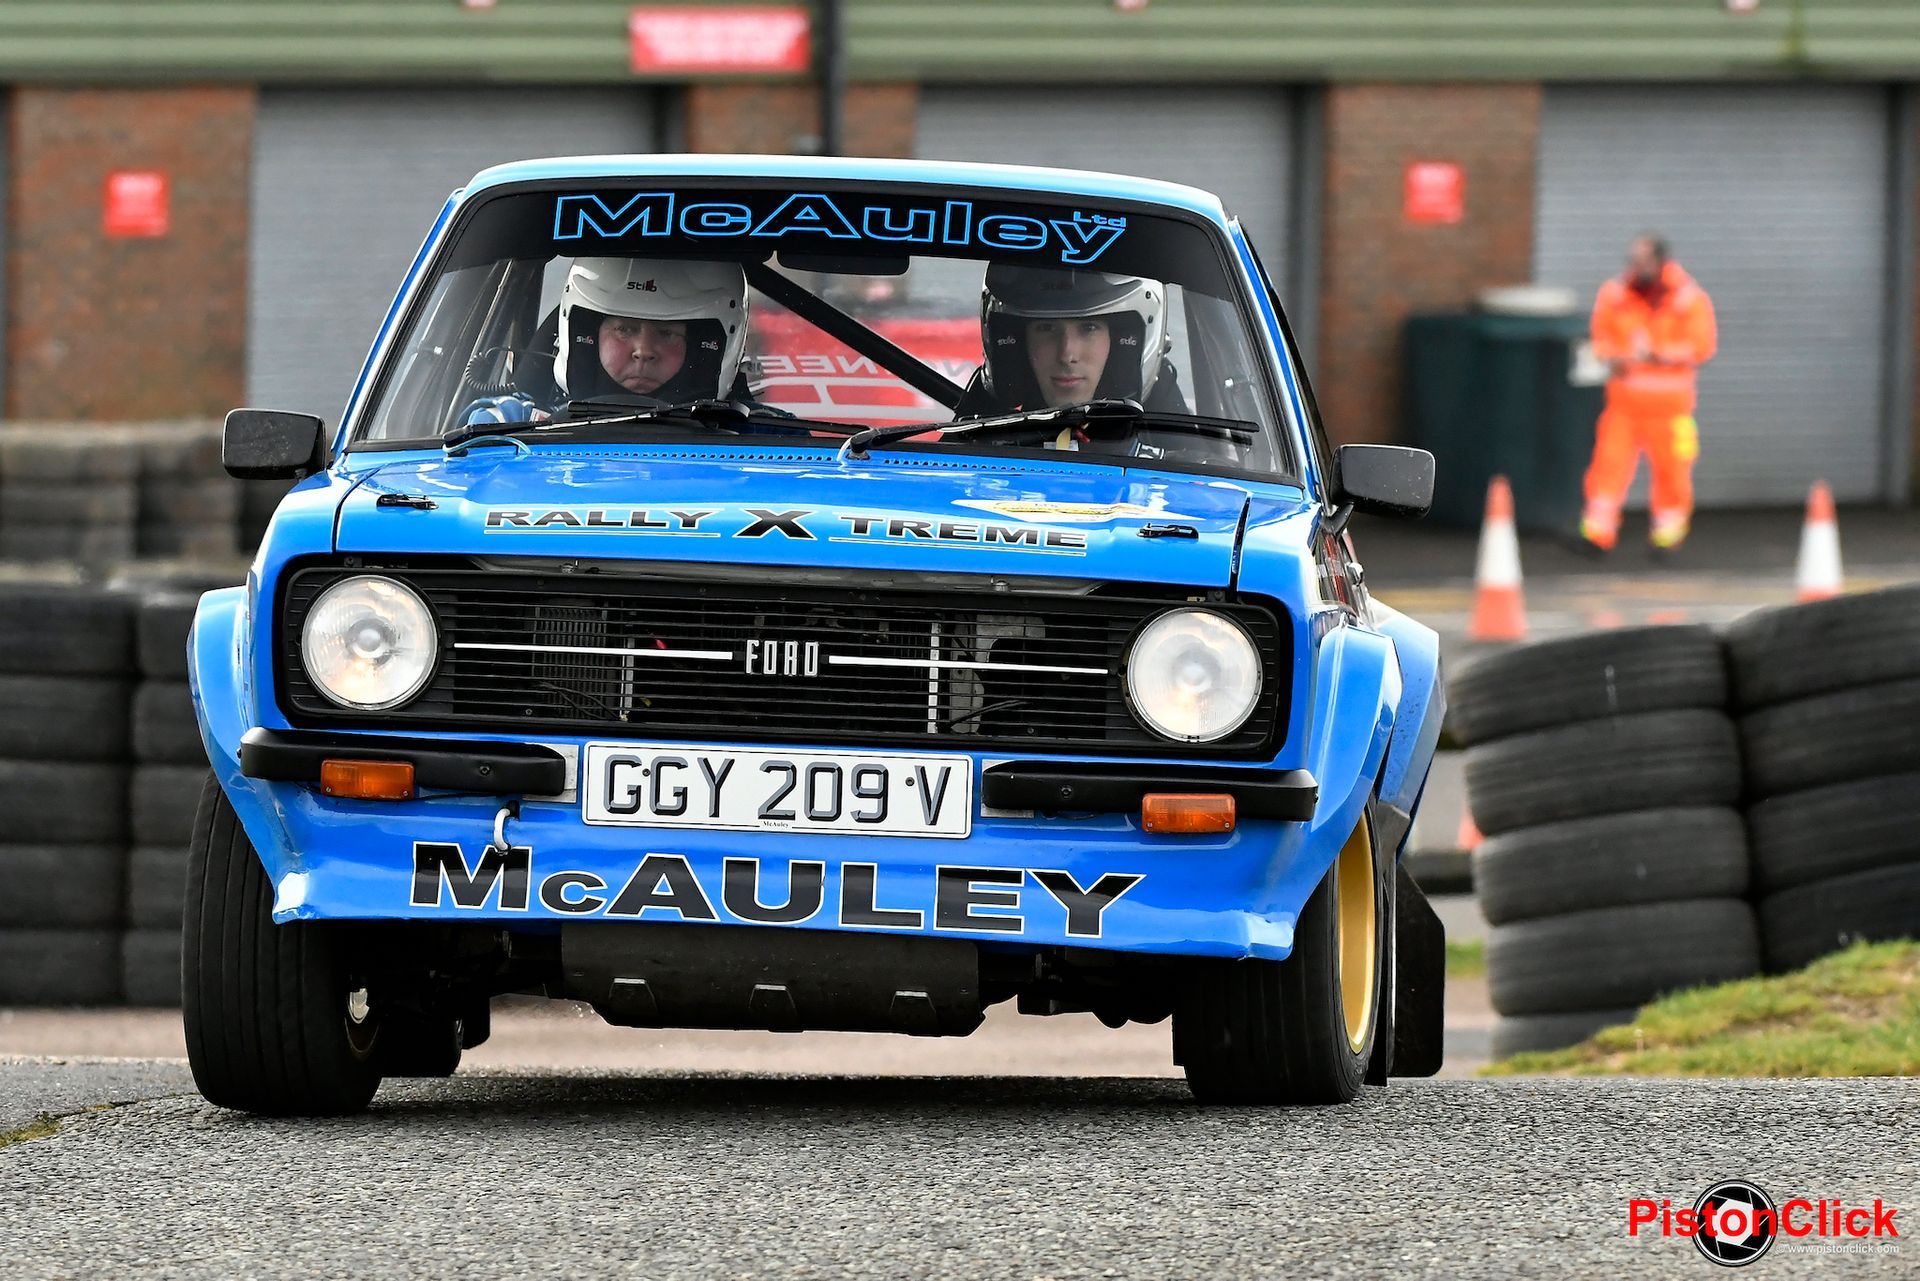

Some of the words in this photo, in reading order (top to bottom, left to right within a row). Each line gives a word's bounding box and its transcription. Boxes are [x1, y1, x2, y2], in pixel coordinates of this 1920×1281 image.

[553, 192, 1126, 264] McAuley
[1073, 210, 1127, 228] Ltd
[486, 508, 723, 530] RALLY
[733, 507, 818, 541] X
[839, 514, 1088, 550] TREME
[745, 639, 820, 677] FORD
[603, 754, 736, 818] GGY
[757, 759, 890, 823] 209
[913, 764, 952, 826] V
[763, 820, 789, 829] McAuley
